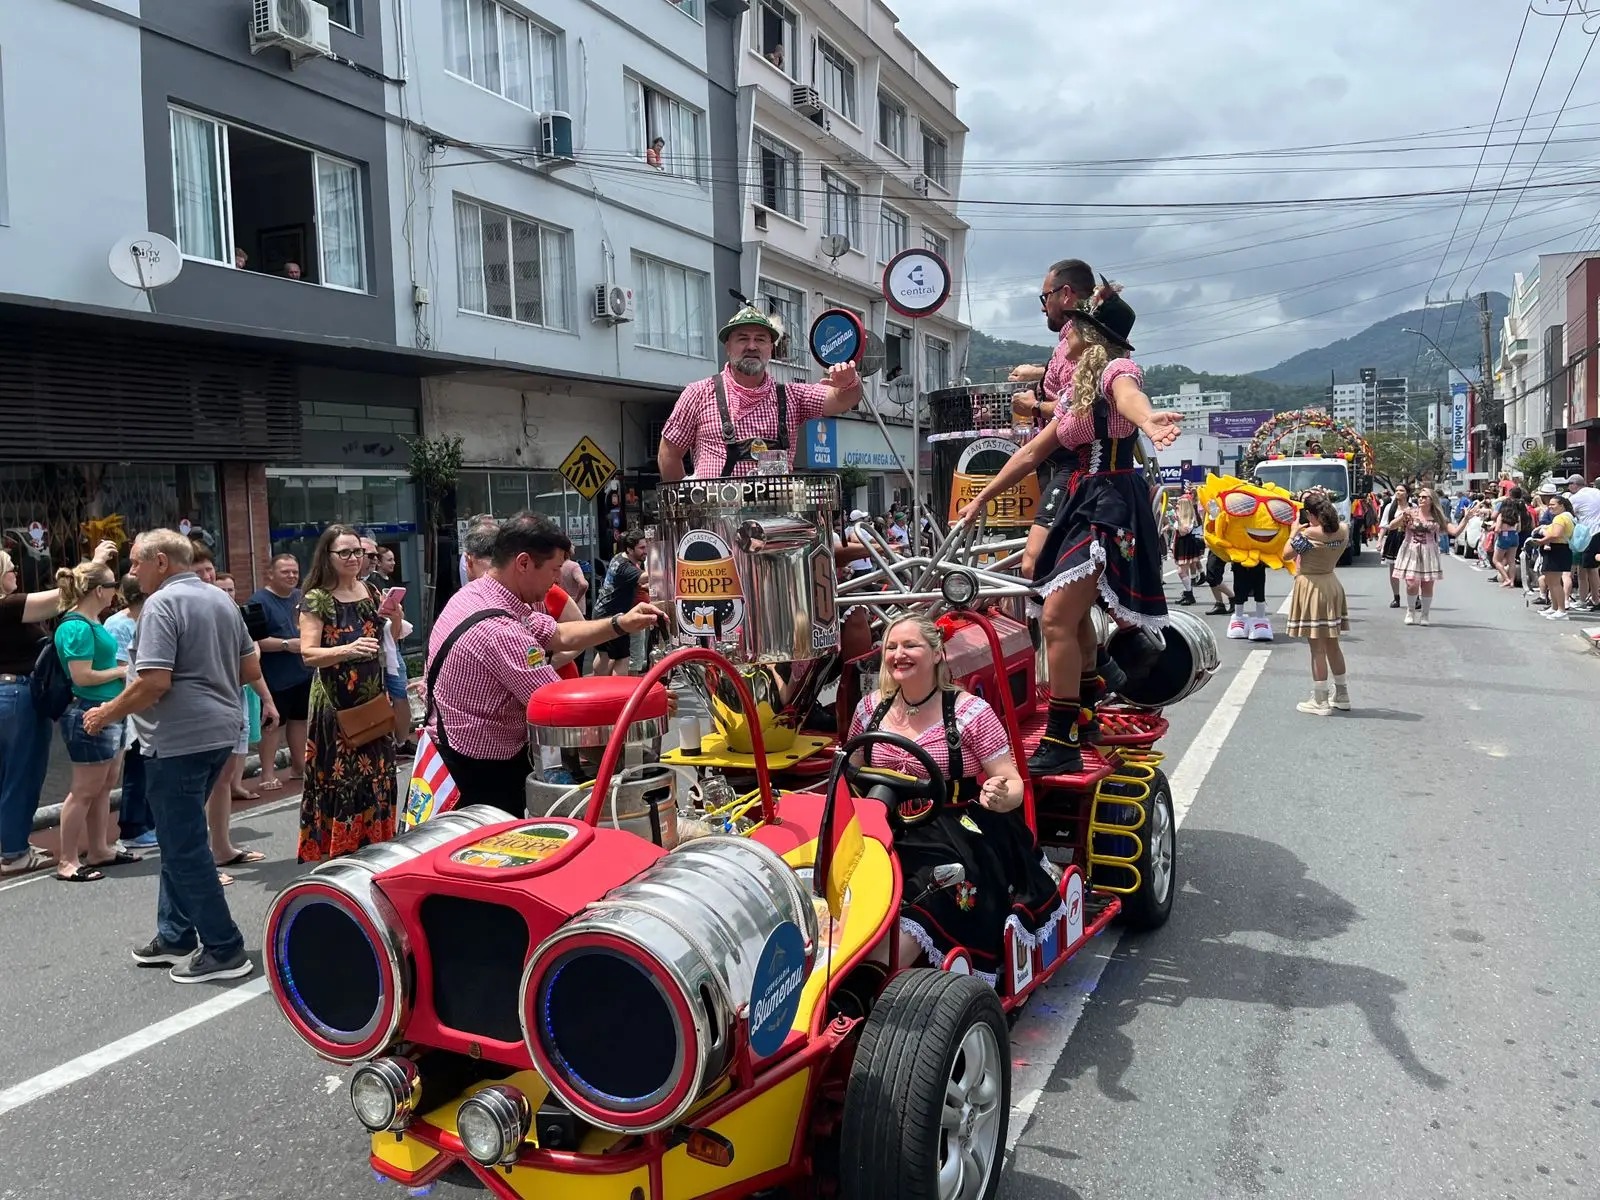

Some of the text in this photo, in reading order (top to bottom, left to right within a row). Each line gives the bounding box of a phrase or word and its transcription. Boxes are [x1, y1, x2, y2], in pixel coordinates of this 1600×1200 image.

[900, 285, 936, 296] central
[820, 329, 854, 357] Blumenau
[1454, 404, 1464, 450] SoluMedi
[873, 455, 889, 465] MEGA
[690, 484, 767, 505] CHOPP
[955, 497, 1034, 517] COPP
[715, 567, 728, 577] DE
[679, 577, 733, 594] CHOPP
[479, 836, 561, 852] CHOPP
[751, 965, 804, 1036] Blumenau
